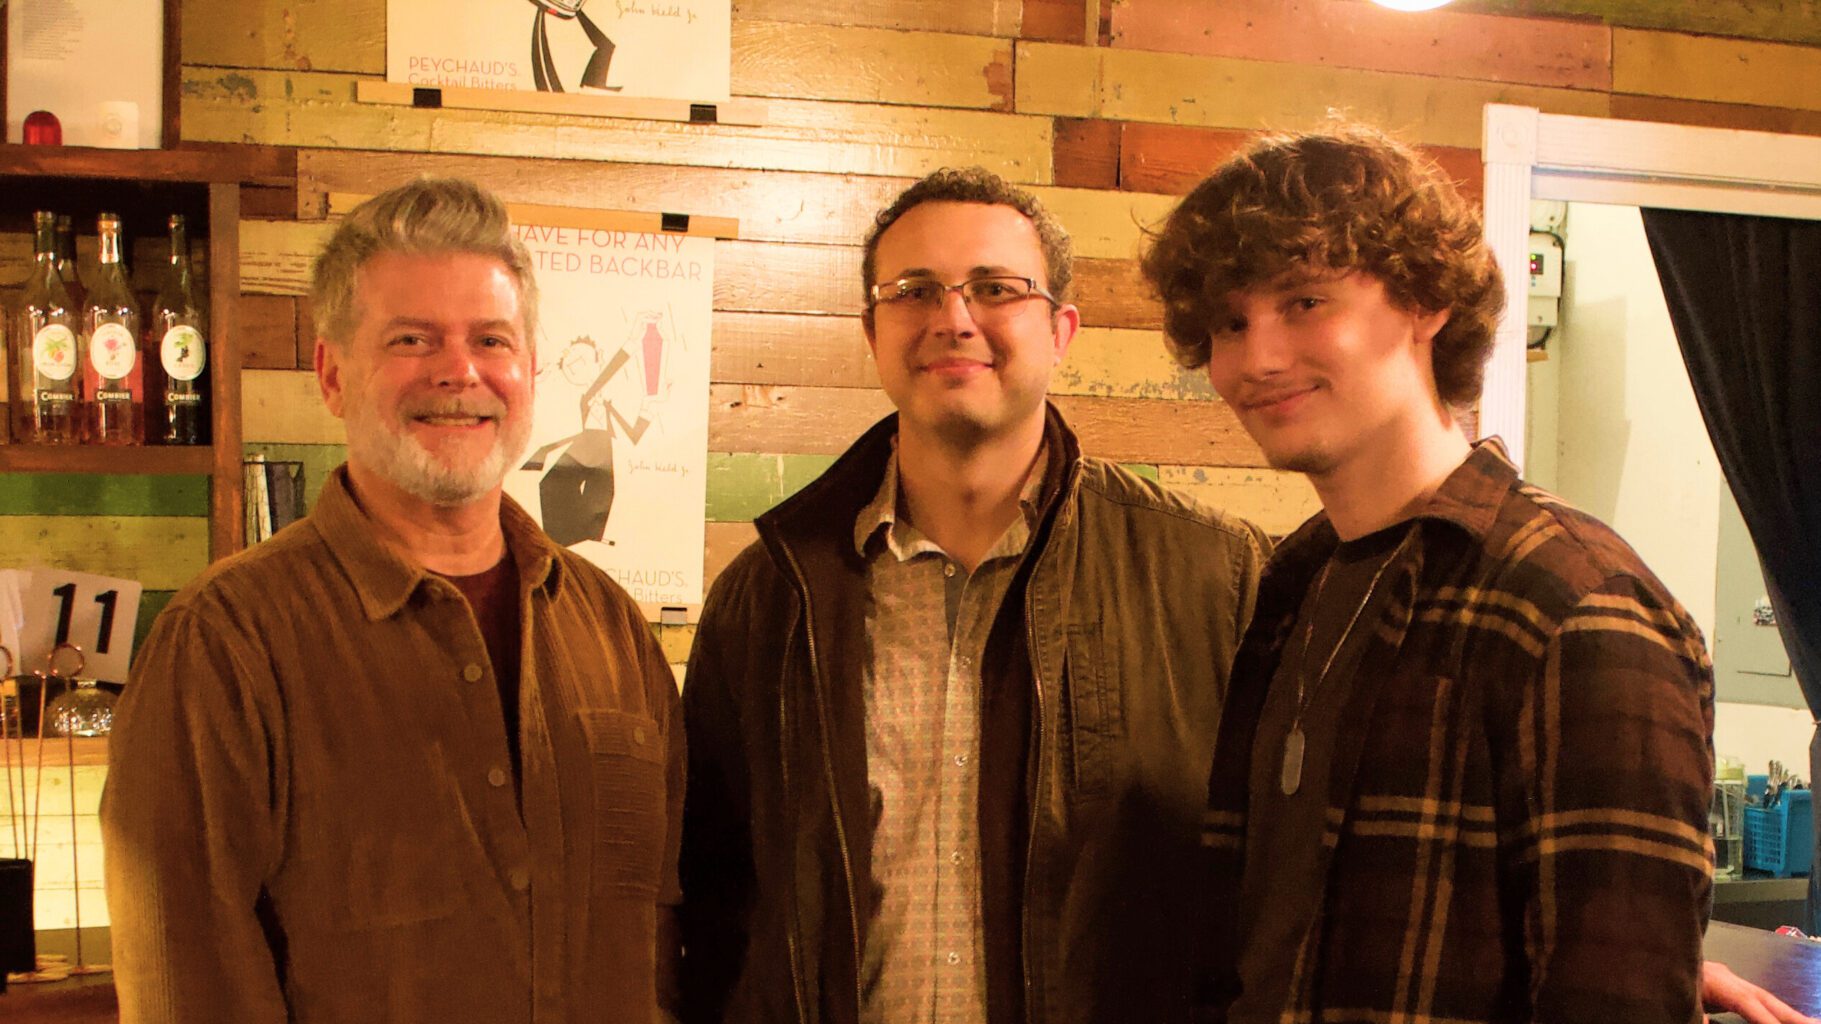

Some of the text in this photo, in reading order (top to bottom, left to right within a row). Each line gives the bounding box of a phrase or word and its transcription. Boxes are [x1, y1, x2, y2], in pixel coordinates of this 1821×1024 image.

[408, 73, 517, 92] Cocktail Bitters
[577, 228, 627, 249] FOR
[635, 232, 687, 253] ANY
[535, 250, 703, 281] TED BACKBAR
[53, 583, 118, 654] 11
